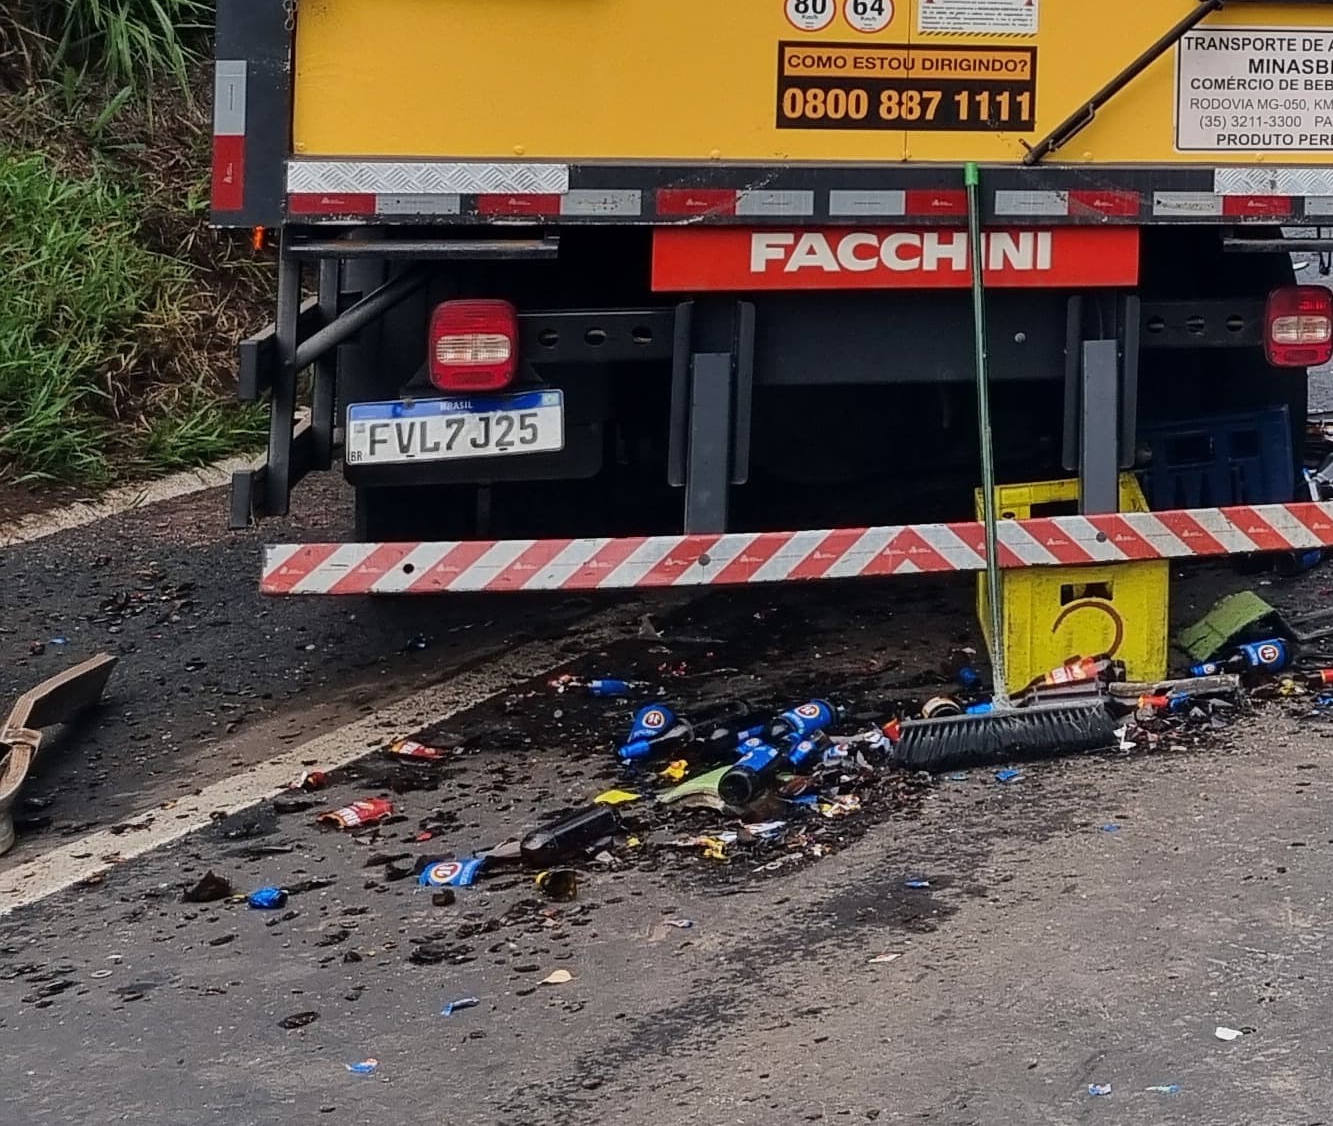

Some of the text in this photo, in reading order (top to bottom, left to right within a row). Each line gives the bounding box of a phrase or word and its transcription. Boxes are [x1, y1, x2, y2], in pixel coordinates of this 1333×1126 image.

[1185, 36, 1297, 53] TRANSPORTE
[1303, 38, 1322, 52] DE
[788, 54, 1028, 74] COMO ESTOU DIRIGINDO?
[1190, 75, 1275, 91] COMÉRCIO
[1279, 79, 1299, 91] DE
[782, 87, 1032, 122] 0800 887 1111
[1190, 98, 1253, 110] RODOVIA
[1257, 98, 1310, 111] MG-050,
[1314, 99, 1333, 110] KM
[1199, 115, 1227, 130] (35)
[1230, 115, 1302, 128] 3211-3300
[1216, 134, 1293, 146] PRODUTO
[750, 231, 1052, 273] FACCHNI
[439, 400, 473, 412] BRASIL
[368, 413, 539, 457] FVL7J25
[350, 450, 364, 462] BR
